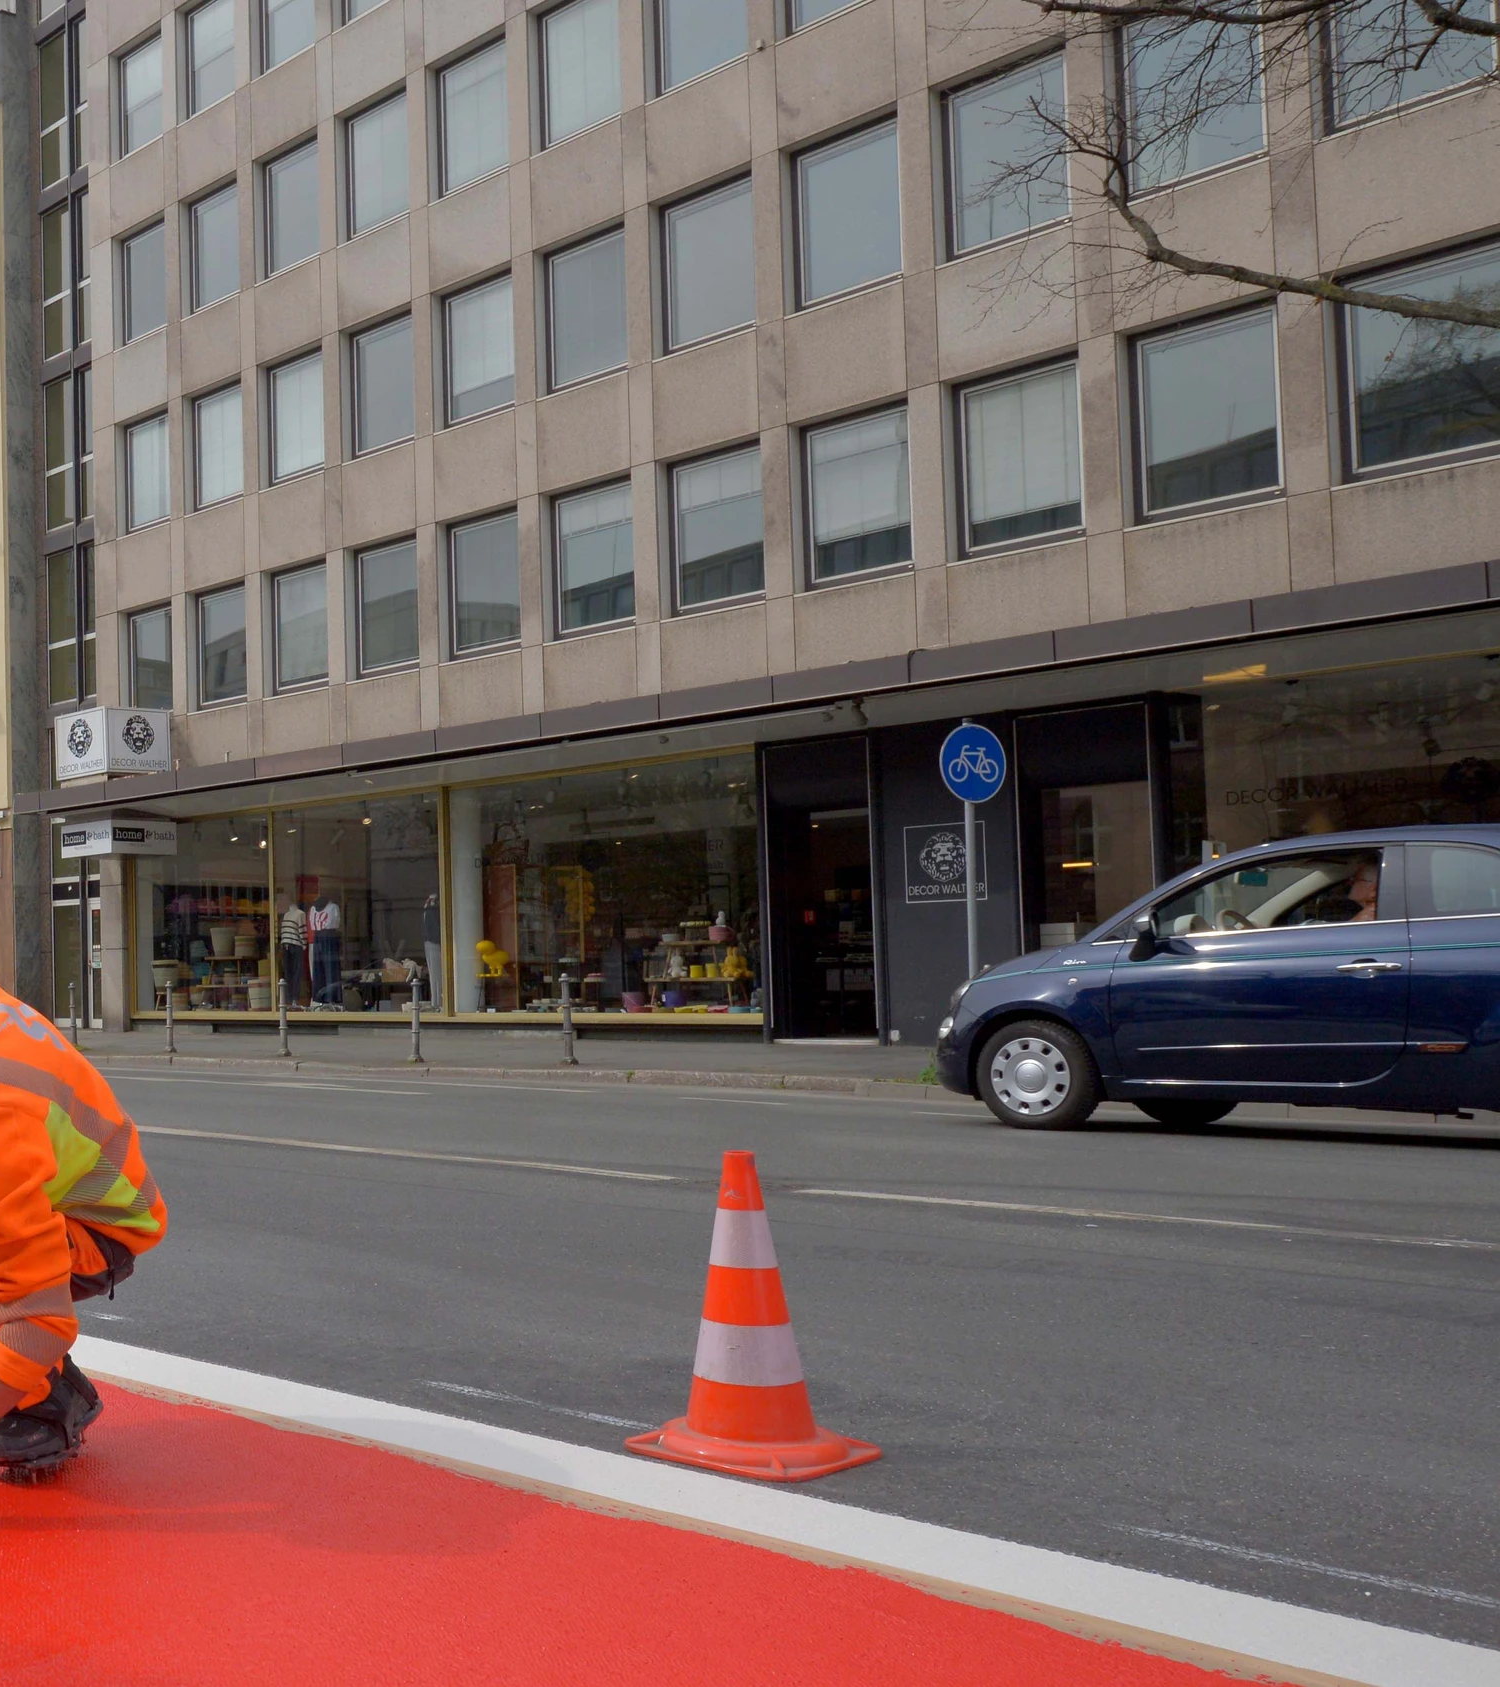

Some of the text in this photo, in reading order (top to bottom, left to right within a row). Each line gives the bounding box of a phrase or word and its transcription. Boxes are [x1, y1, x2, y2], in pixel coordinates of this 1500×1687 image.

[59, 758, 104, 775] DECOR WALTHER
[111, 758, 168, 769] DECOR WALTHER
[1226, 784, 1297, 807] DECOR
[64, 833, 86, 845] home
[93, 829, 110, 841] bath
[115, 828, 142, 840] home
[153, 830, 175, 841] bath
[908, 882, 985, 897] DECOR WALTER
